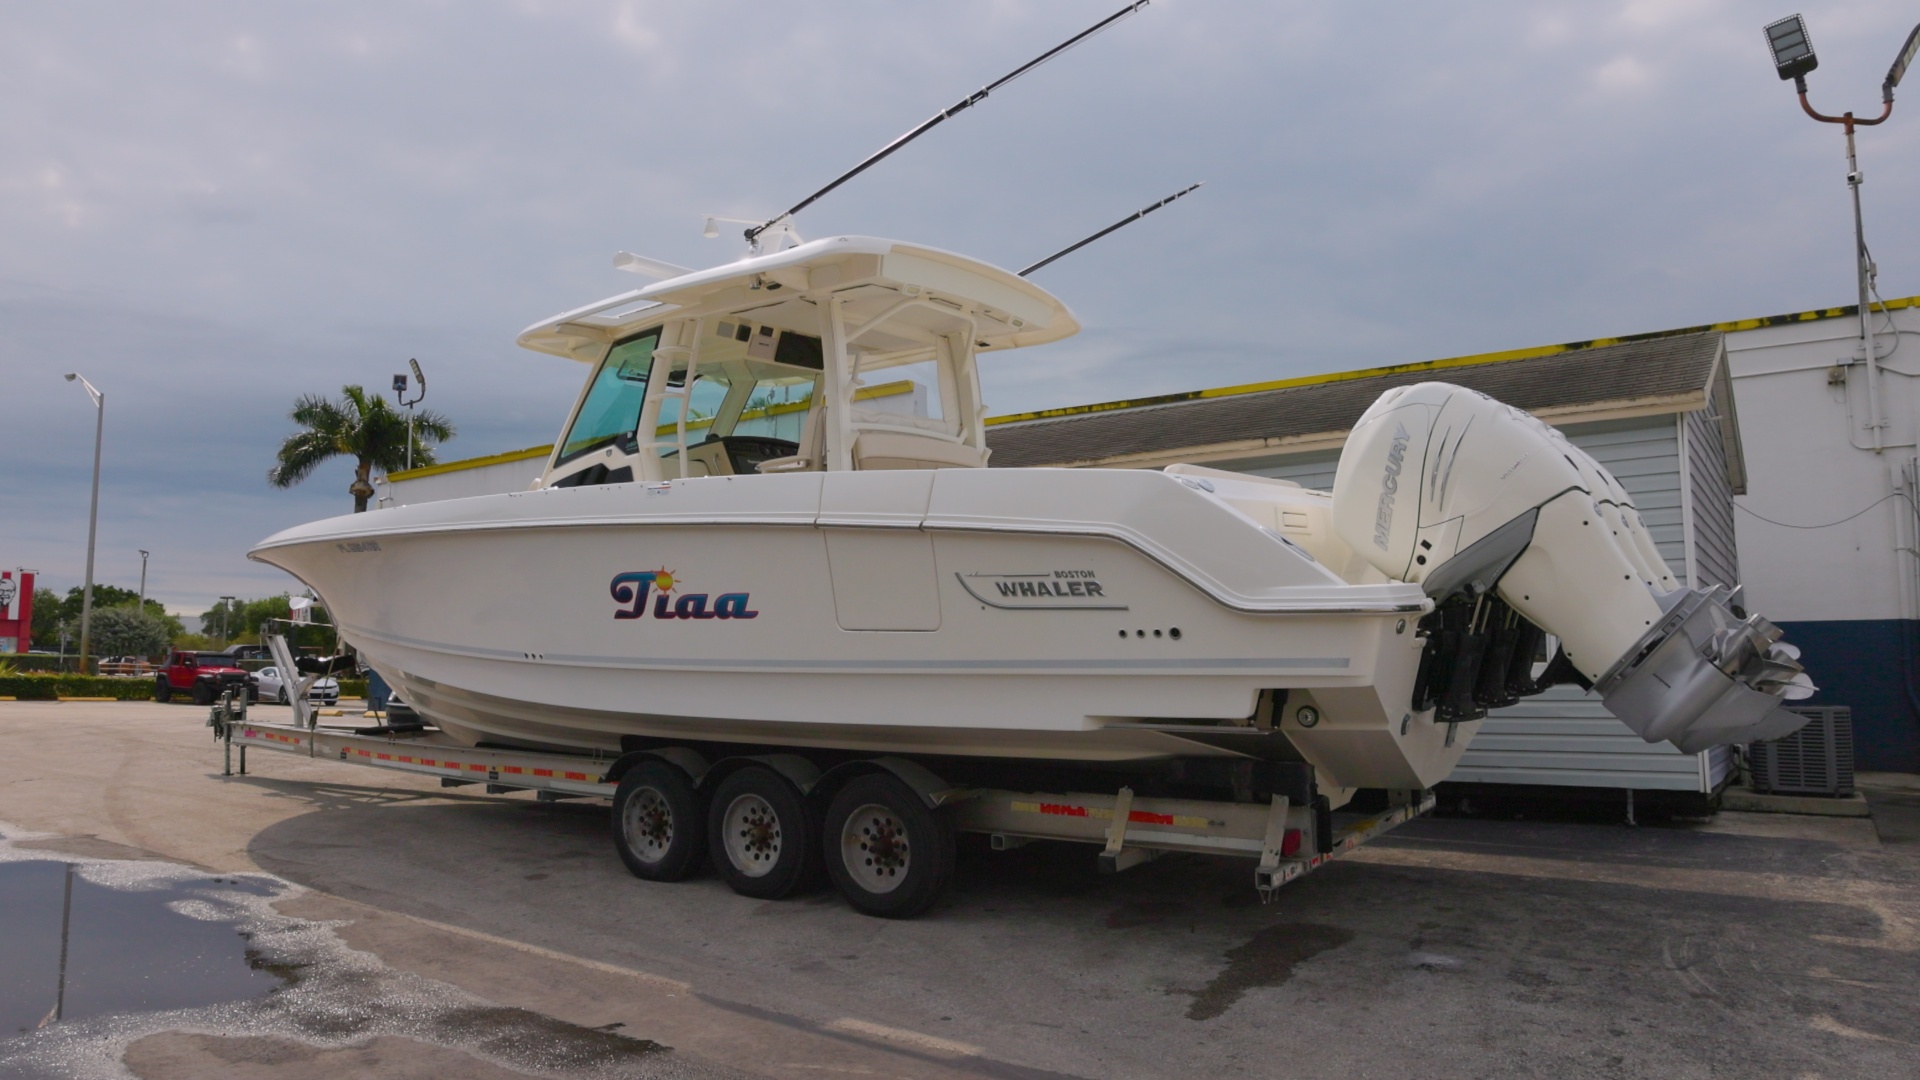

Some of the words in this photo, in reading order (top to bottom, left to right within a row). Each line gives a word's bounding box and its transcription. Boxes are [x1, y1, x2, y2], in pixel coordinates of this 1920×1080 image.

[1373, 421, 1411, 552] MERCURY
[995, 581, 1106, 597] WHALER
[1053, 570, 1096, 579] BOSTON
[610, 567, 759, 620] Tiaa
